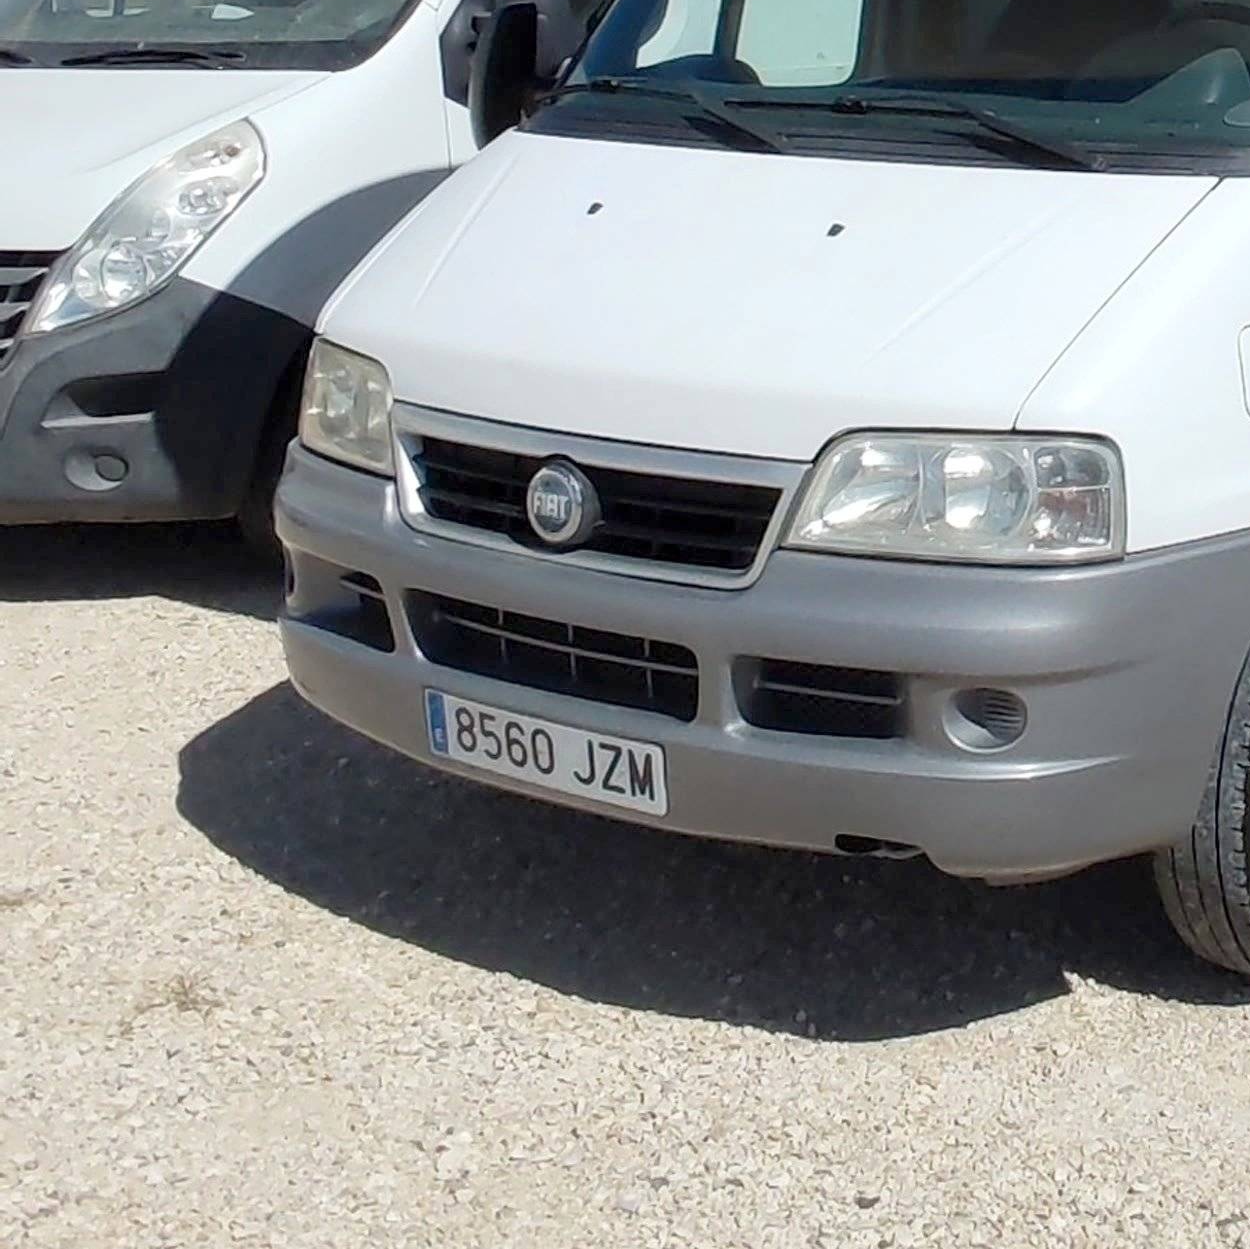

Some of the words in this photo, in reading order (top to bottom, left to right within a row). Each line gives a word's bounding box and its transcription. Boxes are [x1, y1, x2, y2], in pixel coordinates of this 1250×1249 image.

[533, 491, 569, 520] FIAT
[455, 707, 555, 774] 8560
[573, 739, 655, 801] JZM
